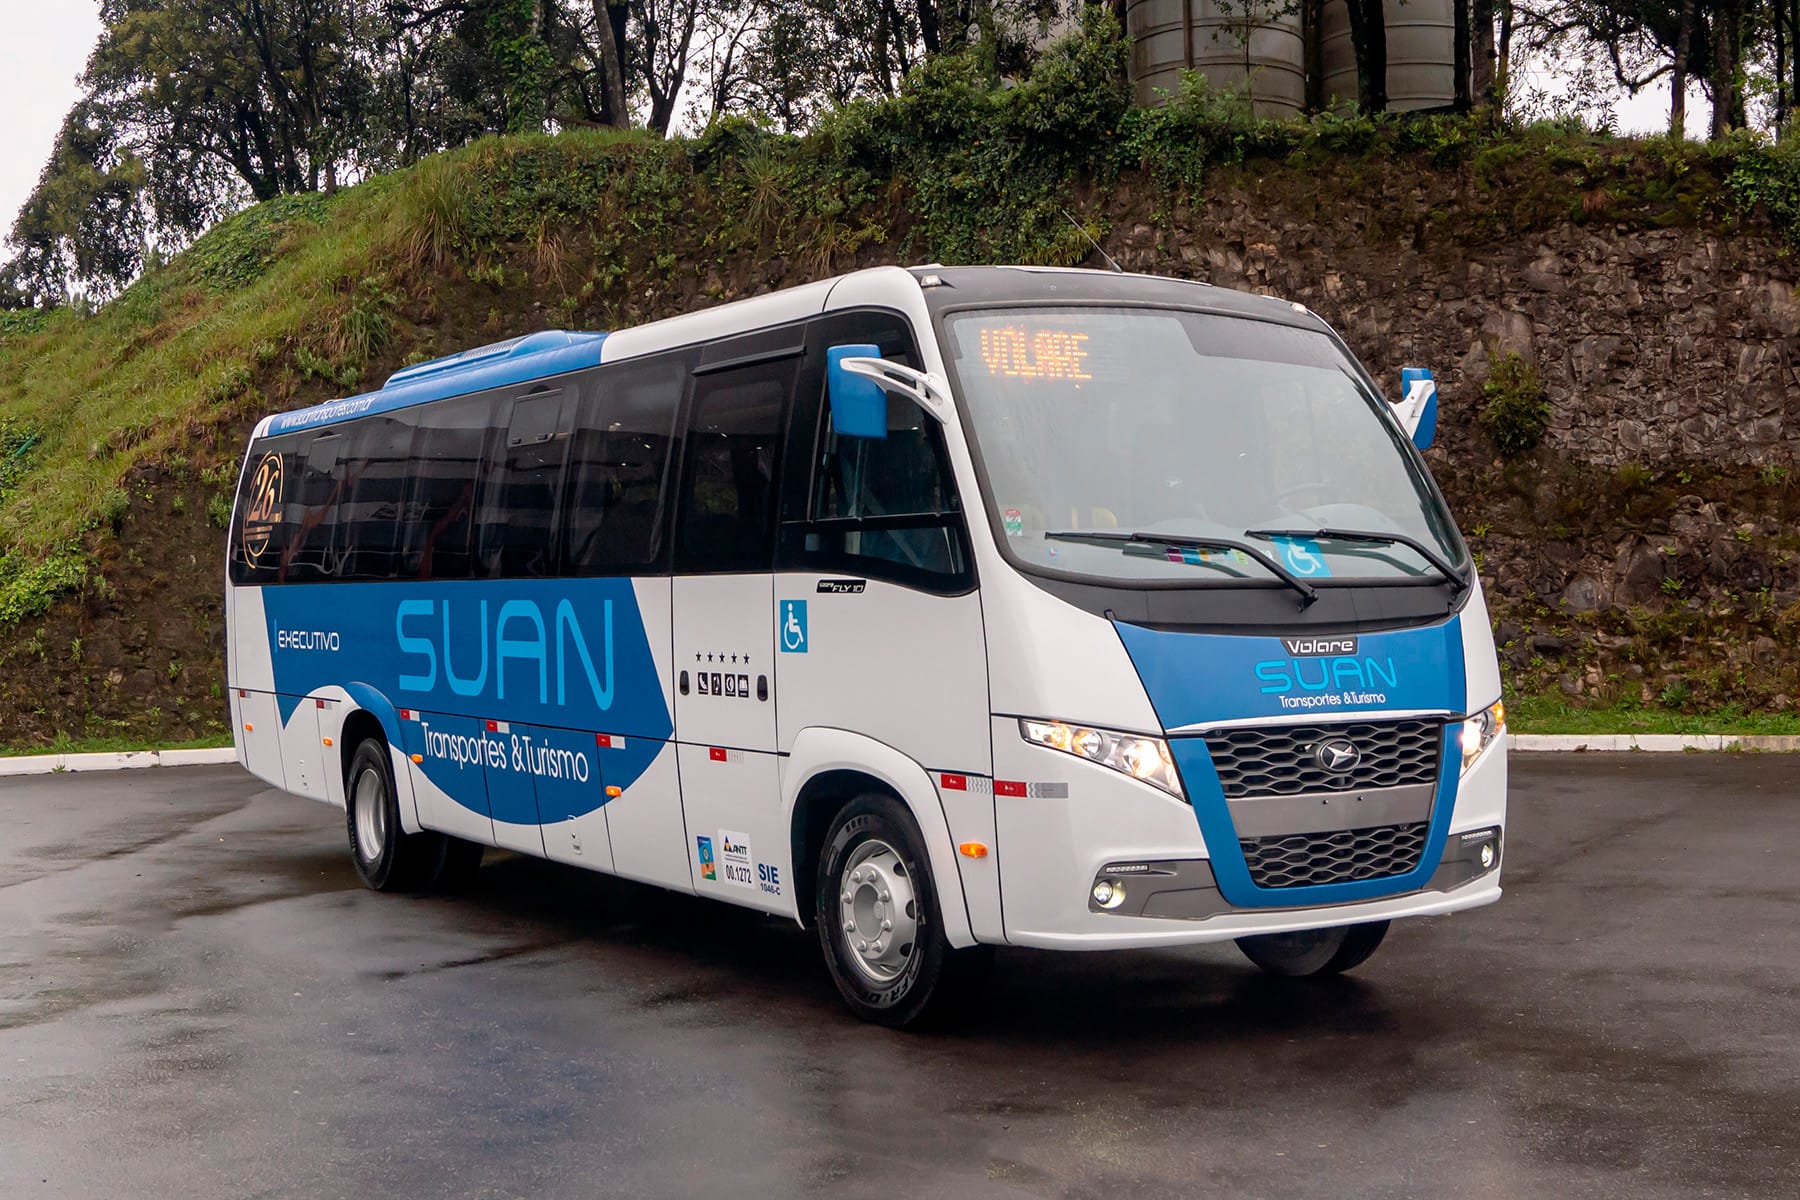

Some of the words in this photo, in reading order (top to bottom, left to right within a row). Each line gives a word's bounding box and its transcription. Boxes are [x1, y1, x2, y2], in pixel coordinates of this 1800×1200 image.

[981, 329, 1092, 379] VOLARE
[247, 463, 280, 521] 26
[832, 584, 851, 593] FLY
[278, 629, 340, 651] EXECUTIVO
[1287, 639, 1353, 654] Volare
[396, 598, 614, 711] SUAN
[1254, 656, 1398, 694] SUAN
[1279, 692, 1341, 709] Transportes
[421, 721, 507, 769] Transportes
[732, 844, 747, 855] ANTT
[725, 864, 752, 884] 00.1272
[758, 863, 779, 884] SIE
